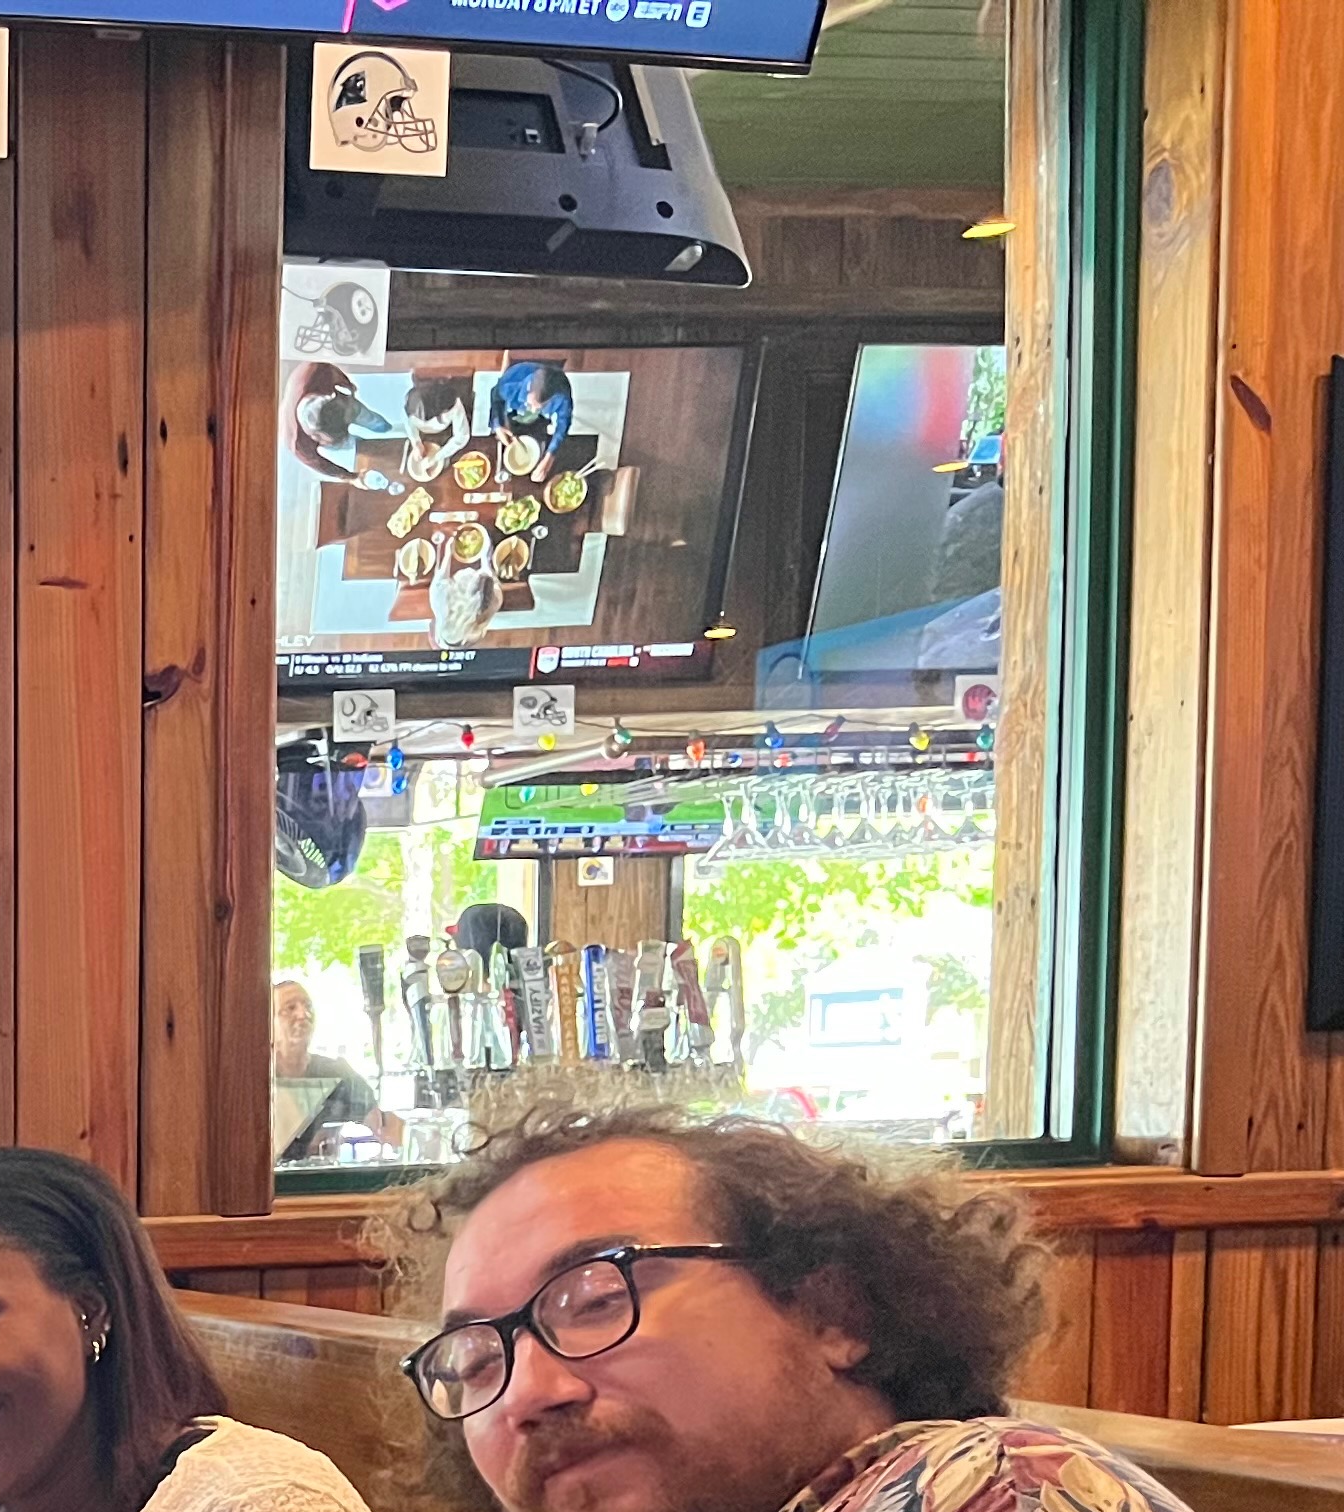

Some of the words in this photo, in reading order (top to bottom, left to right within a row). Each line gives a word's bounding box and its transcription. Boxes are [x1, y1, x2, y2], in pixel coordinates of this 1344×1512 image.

[633, 1, 682, 21] ESPN
[593, 962, 607, 1009] LIGHT
[595, 1011, 609, 1044] BUD
